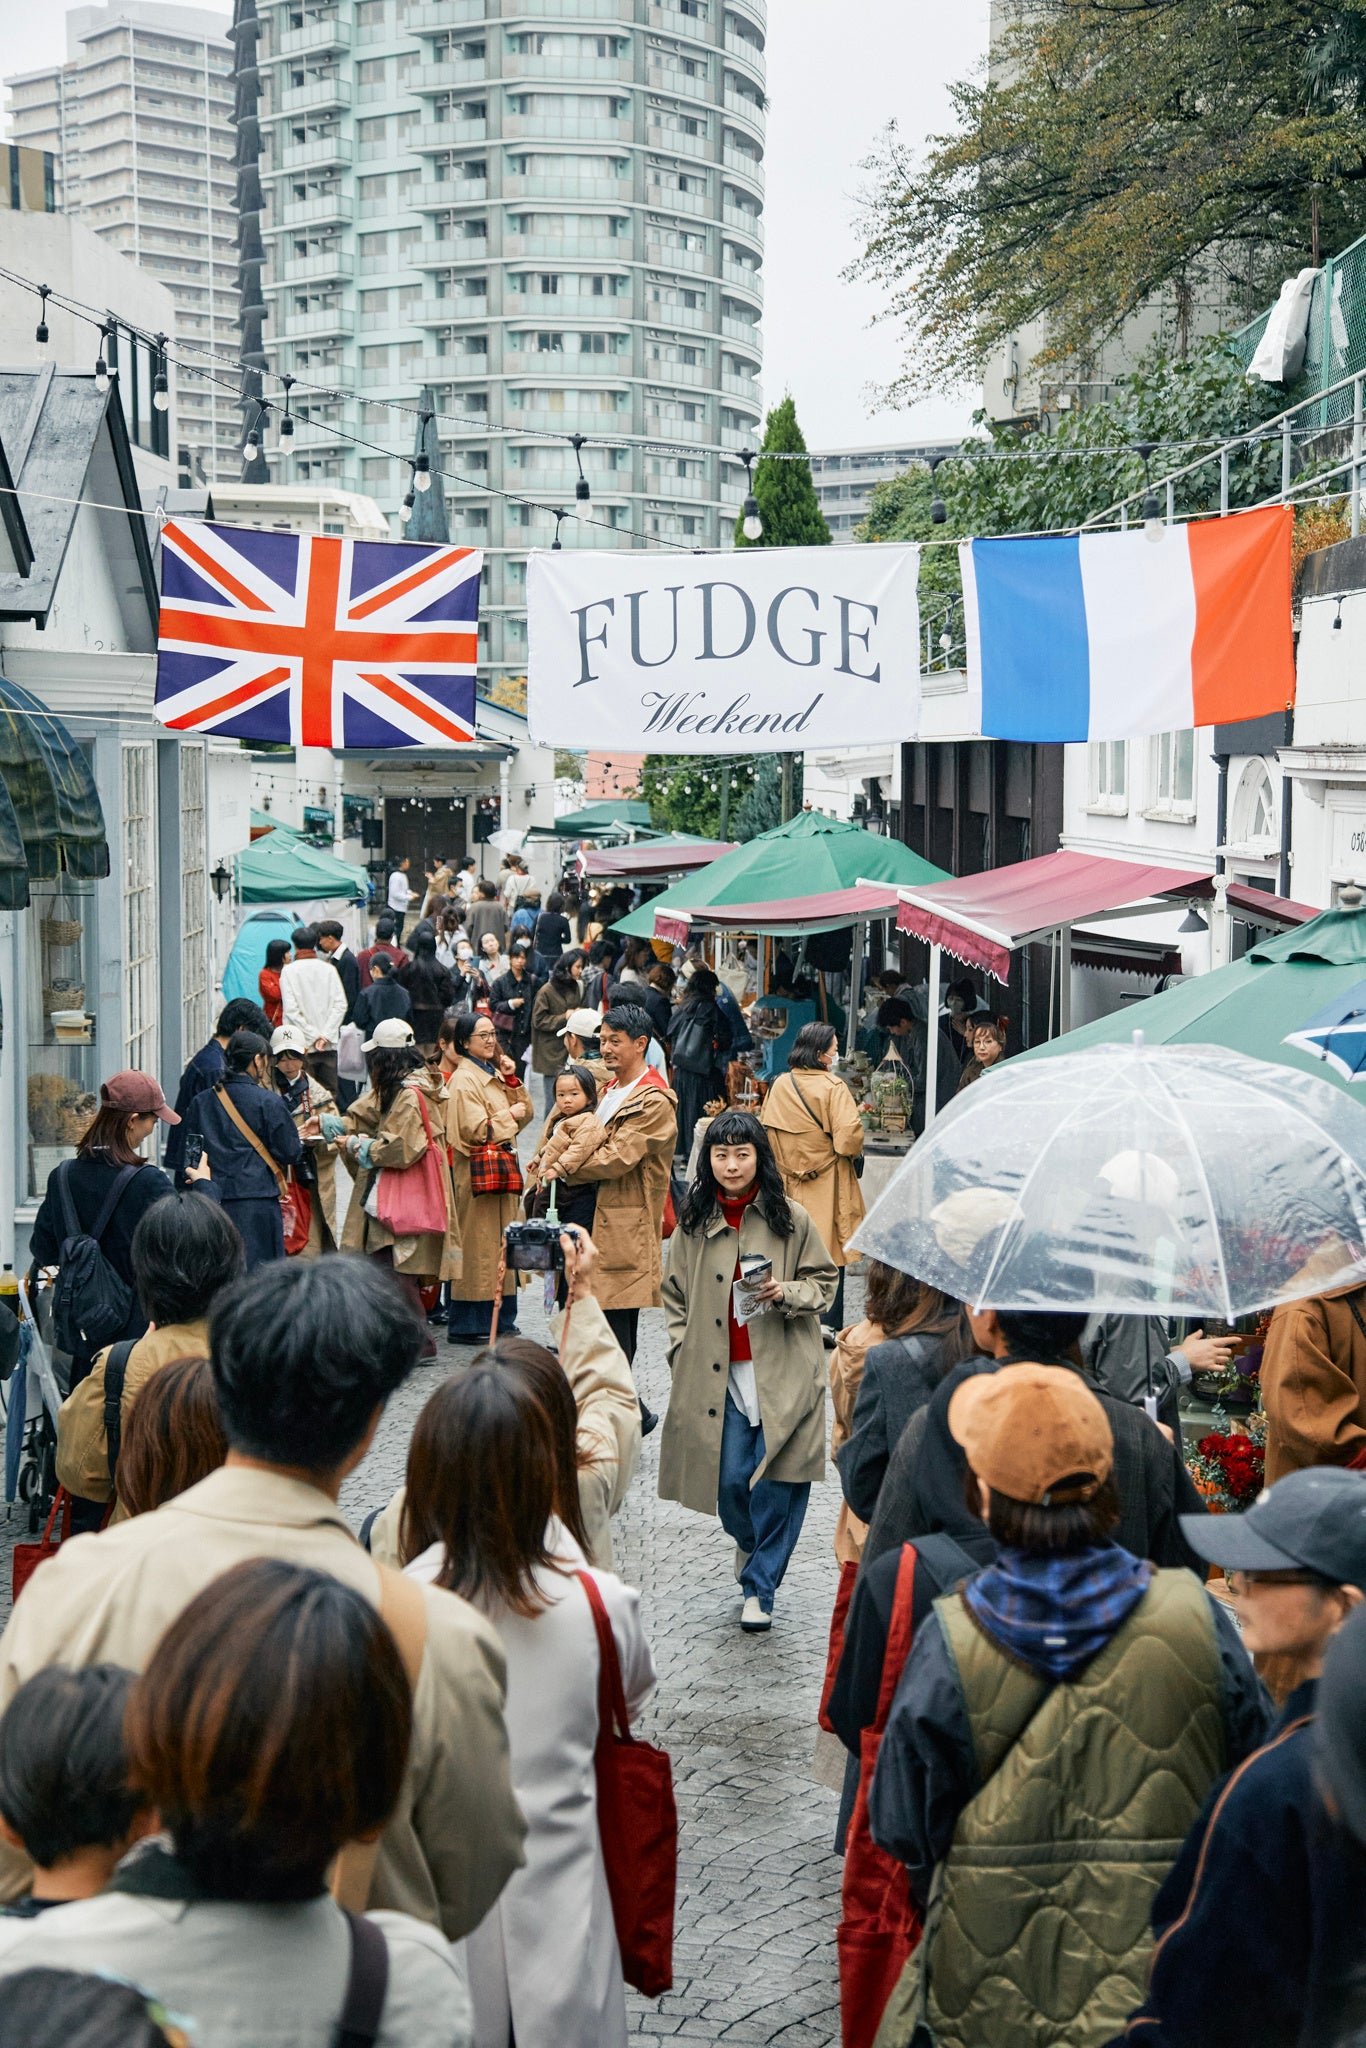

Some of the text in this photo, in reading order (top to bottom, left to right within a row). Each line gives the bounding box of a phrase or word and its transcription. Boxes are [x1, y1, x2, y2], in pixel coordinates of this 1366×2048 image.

[570, 581, 881, 688] FUDGE
[641, 691, 824, 734] Weekend
[1350, 831, 1366, 852] 058
